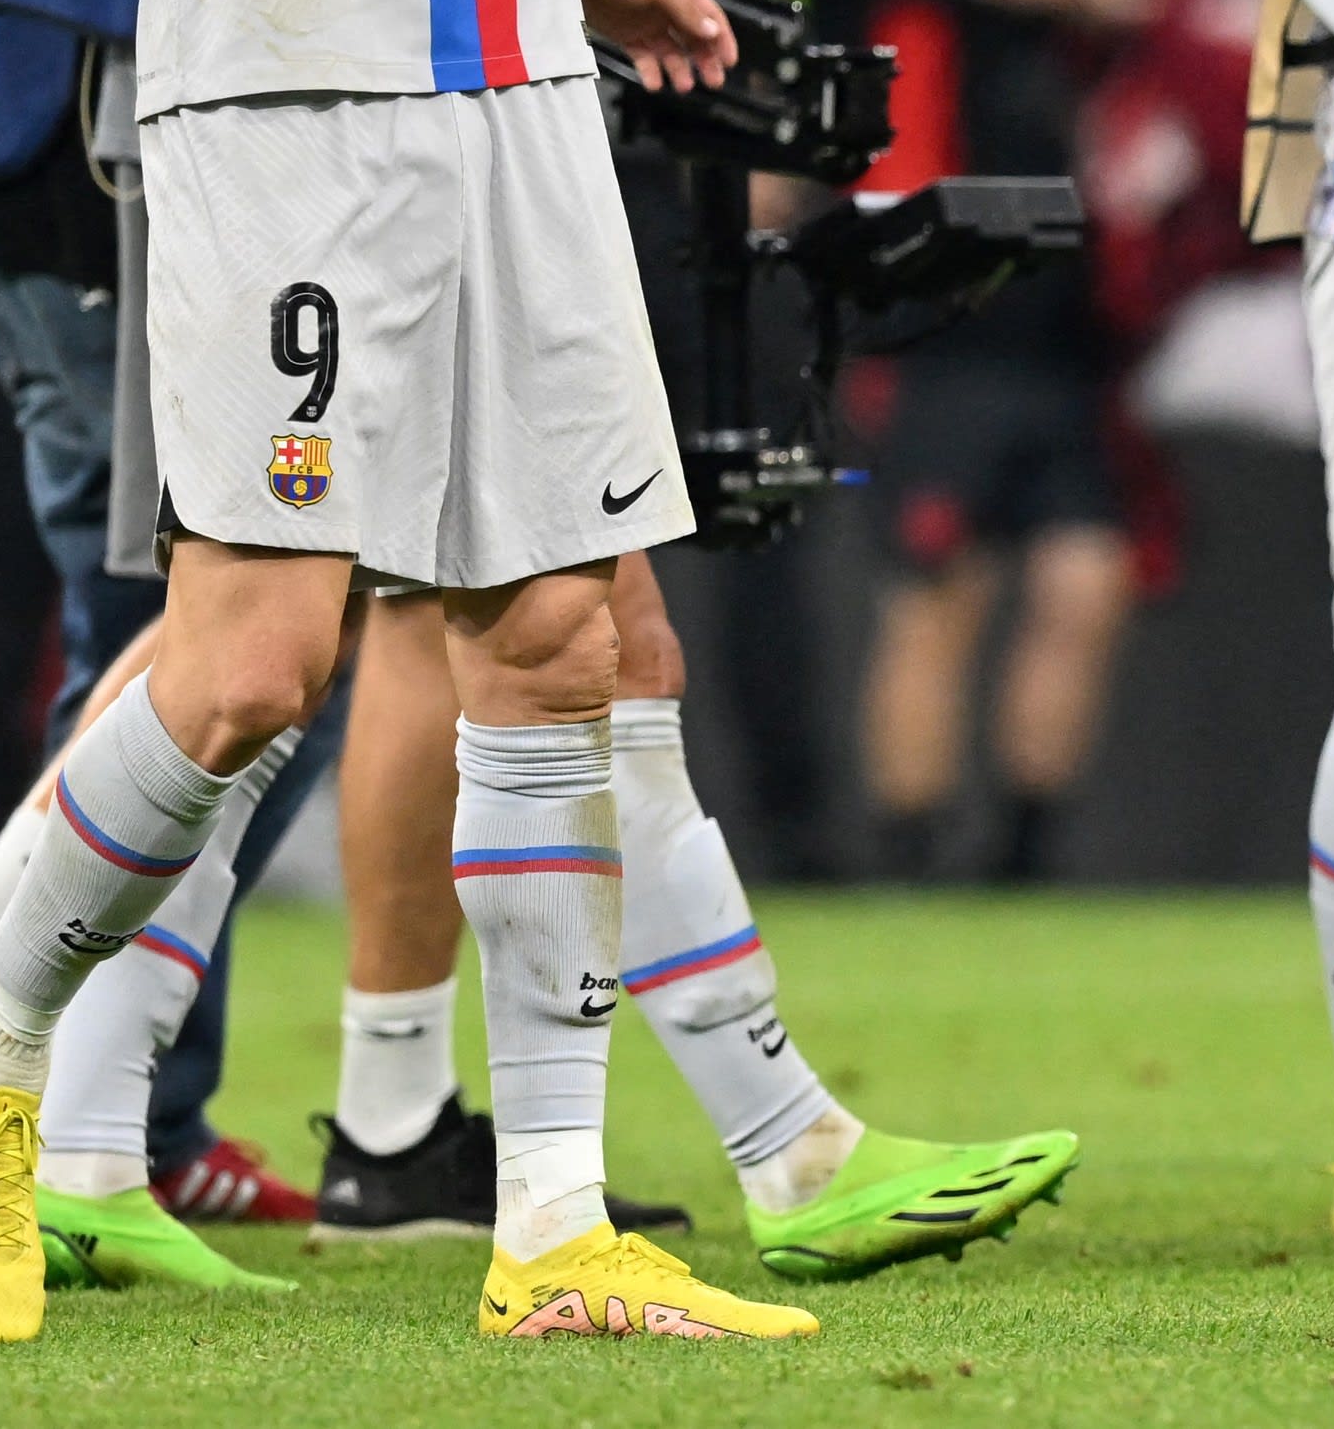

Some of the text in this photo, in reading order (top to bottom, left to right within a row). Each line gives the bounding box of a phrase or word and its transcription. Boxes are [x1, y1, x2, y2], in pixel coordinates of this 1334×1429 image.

[270, 281, 339, 423] 9
[289, 465, 314, 475] FCB
[579, 971, 619, 992] bar
